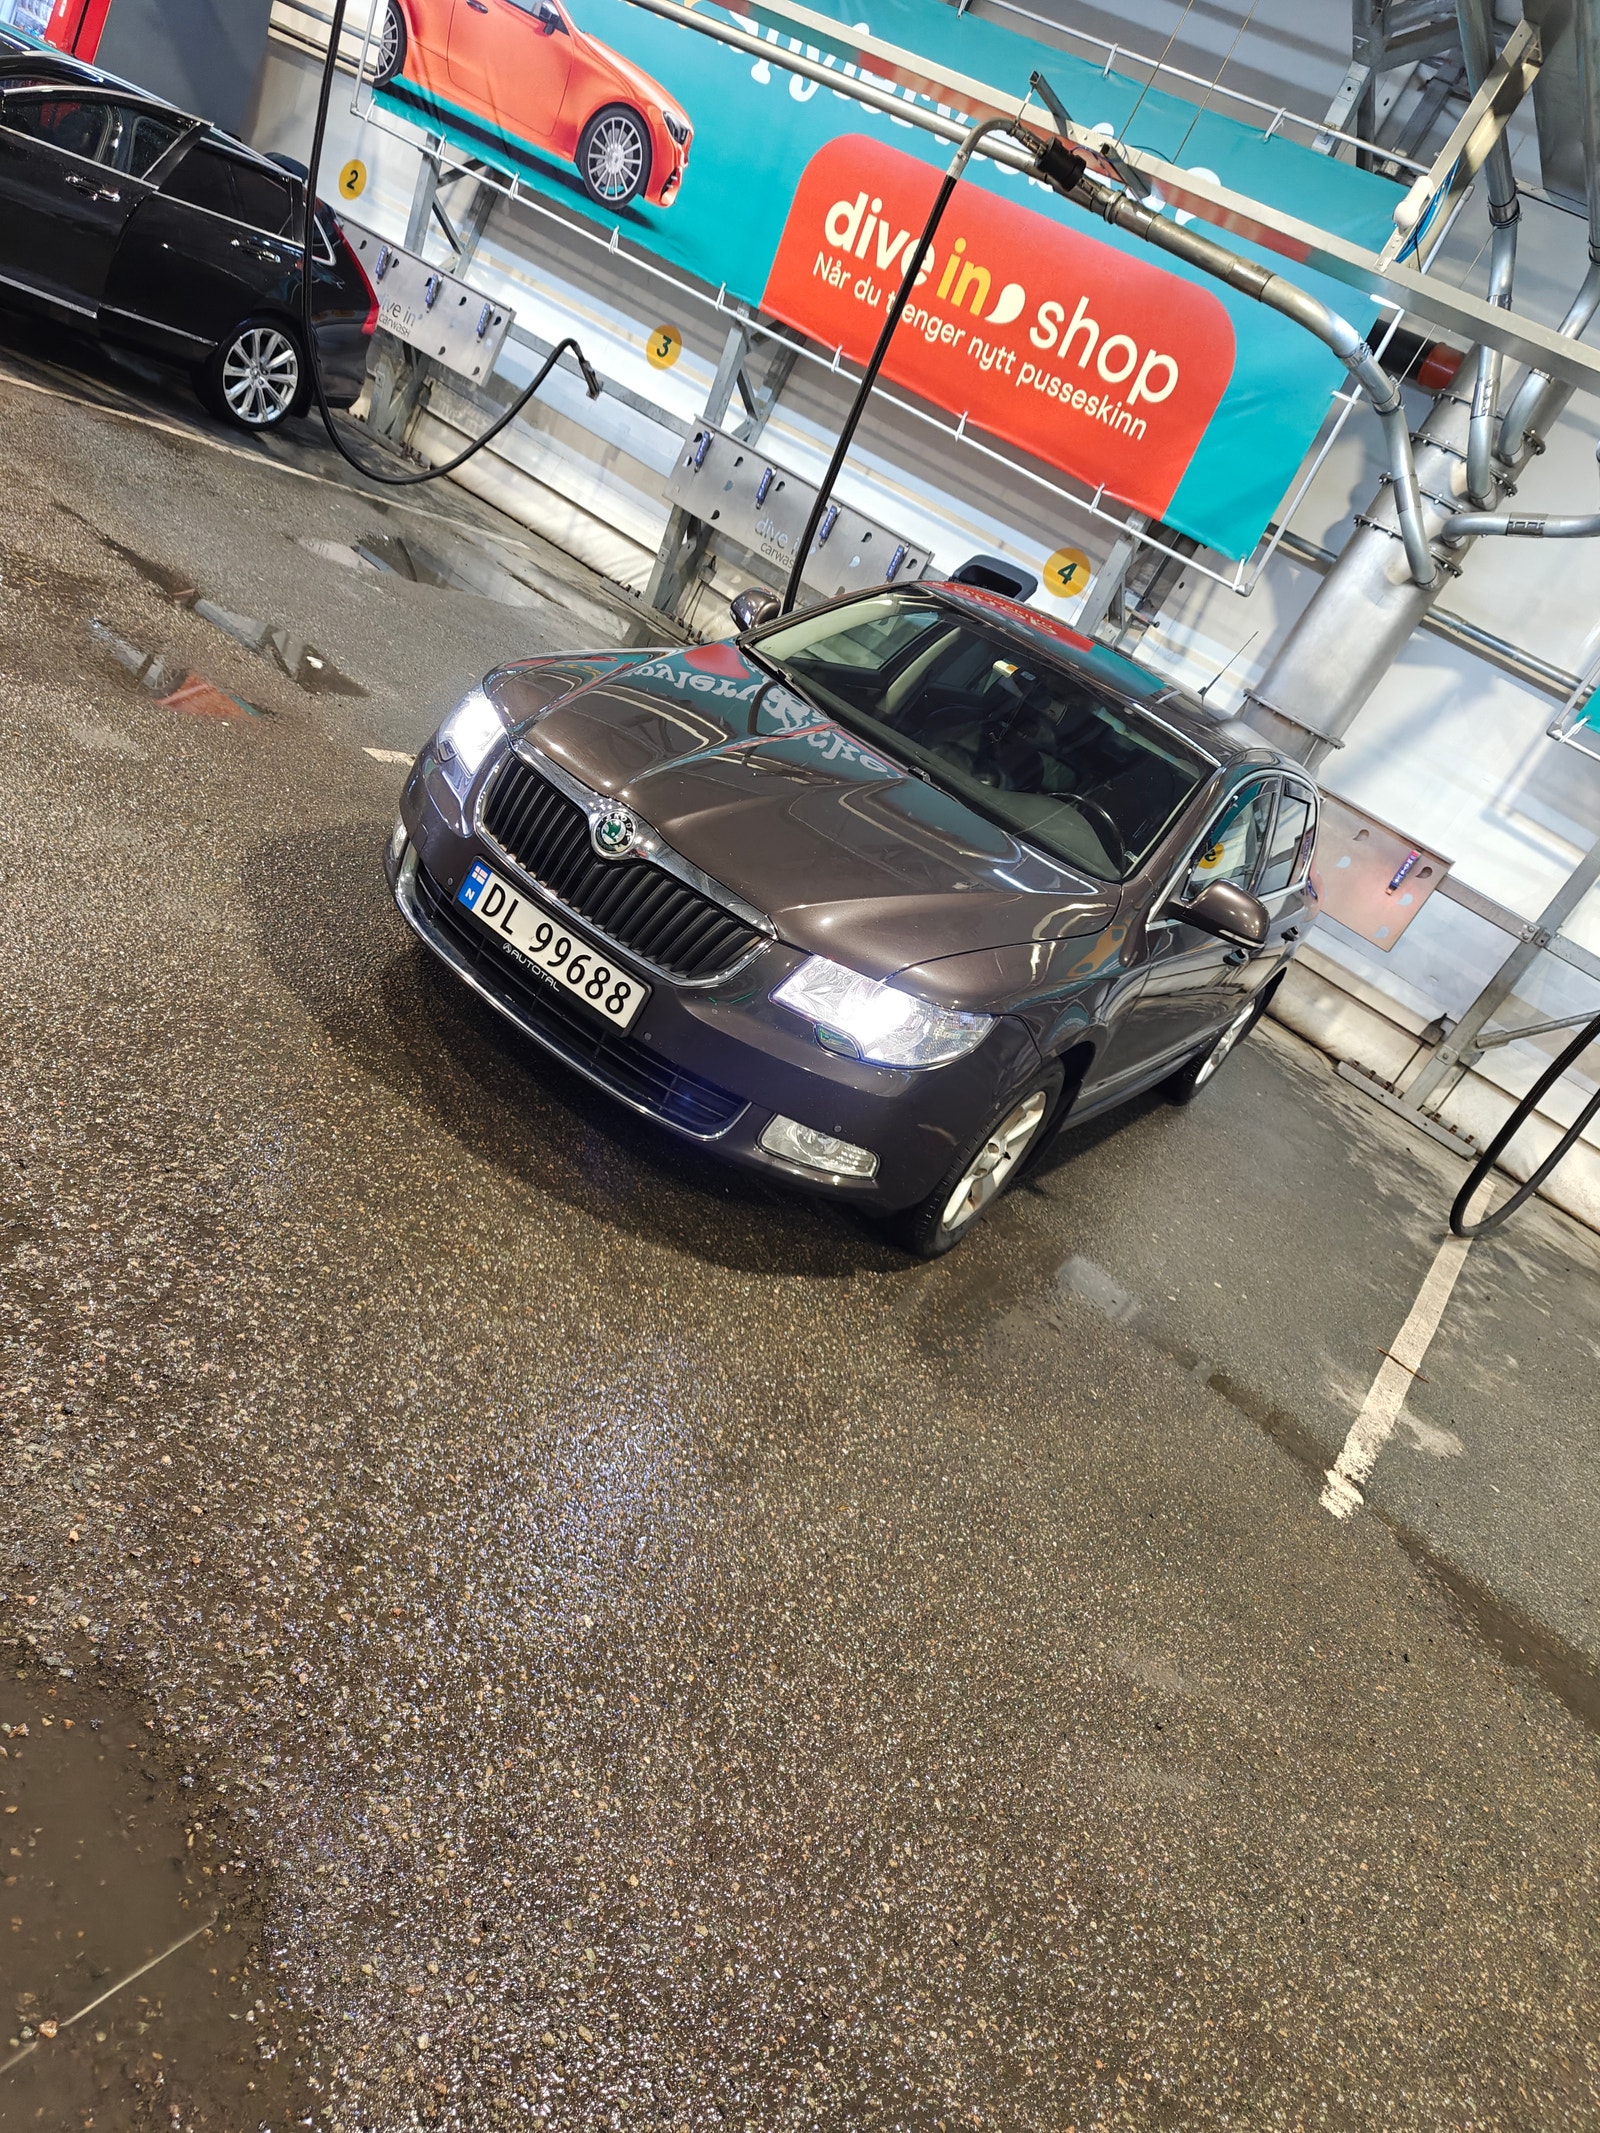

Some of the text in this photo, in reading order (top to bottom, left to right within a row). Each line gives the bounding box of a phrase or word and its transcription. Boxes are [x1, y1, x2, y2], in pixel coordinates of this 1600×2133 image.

[346, 169, 359, 191] 2
[824, 191, 1180, 405] dive in shop
[656, 334, 672, 358] 3
[812, 250, 1148, 441] Når du tenger nytt pusseskinn
[760, 542, 796, 569] carwas
[1057, 562, 1078, 586] 4
[465, 887, 476, 901] N
[480, 882, 632, 1015] DL 99688
[510, 949, 560, 993] AUTOTAL
